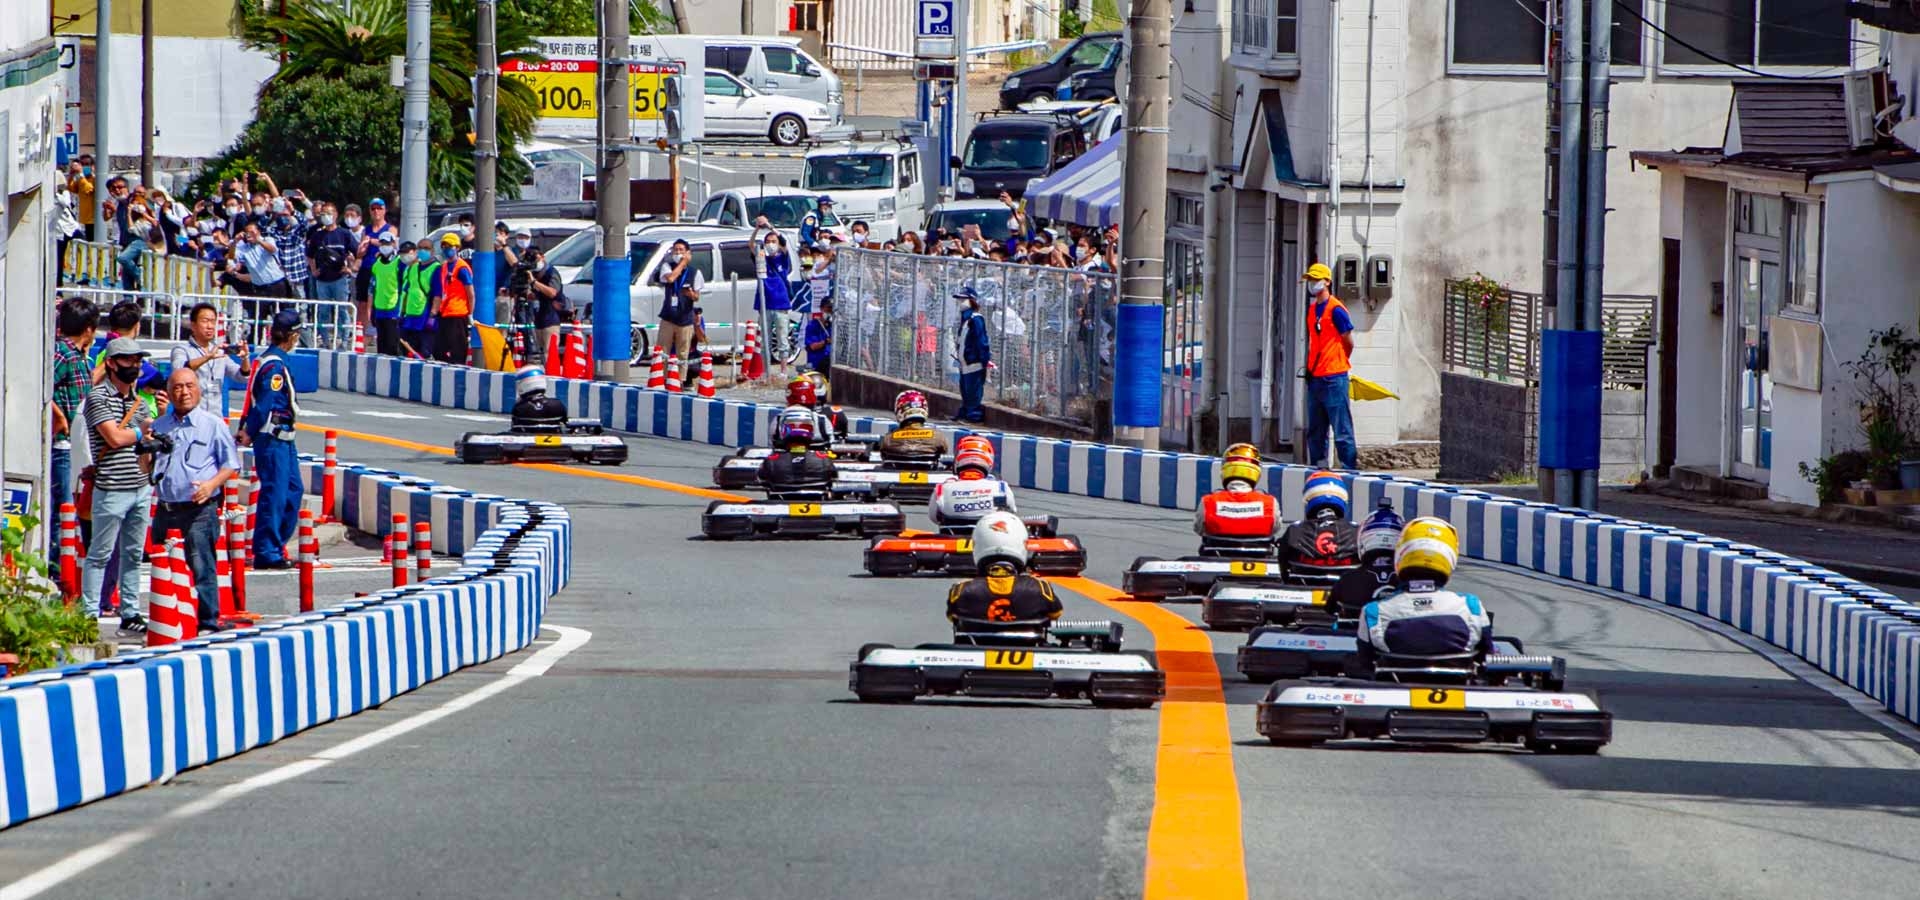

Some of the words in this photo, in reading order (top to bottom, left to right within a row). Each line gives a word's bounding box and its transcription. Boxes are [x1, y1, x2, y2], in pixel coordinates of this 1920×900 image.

[923, 3, 949, 34] P
[934, 25, 950, 33] 入口
[908, 471, 919, 481] 4
[798, 503, 811, 514] 3
[994, 649, 1027, 665] 10
